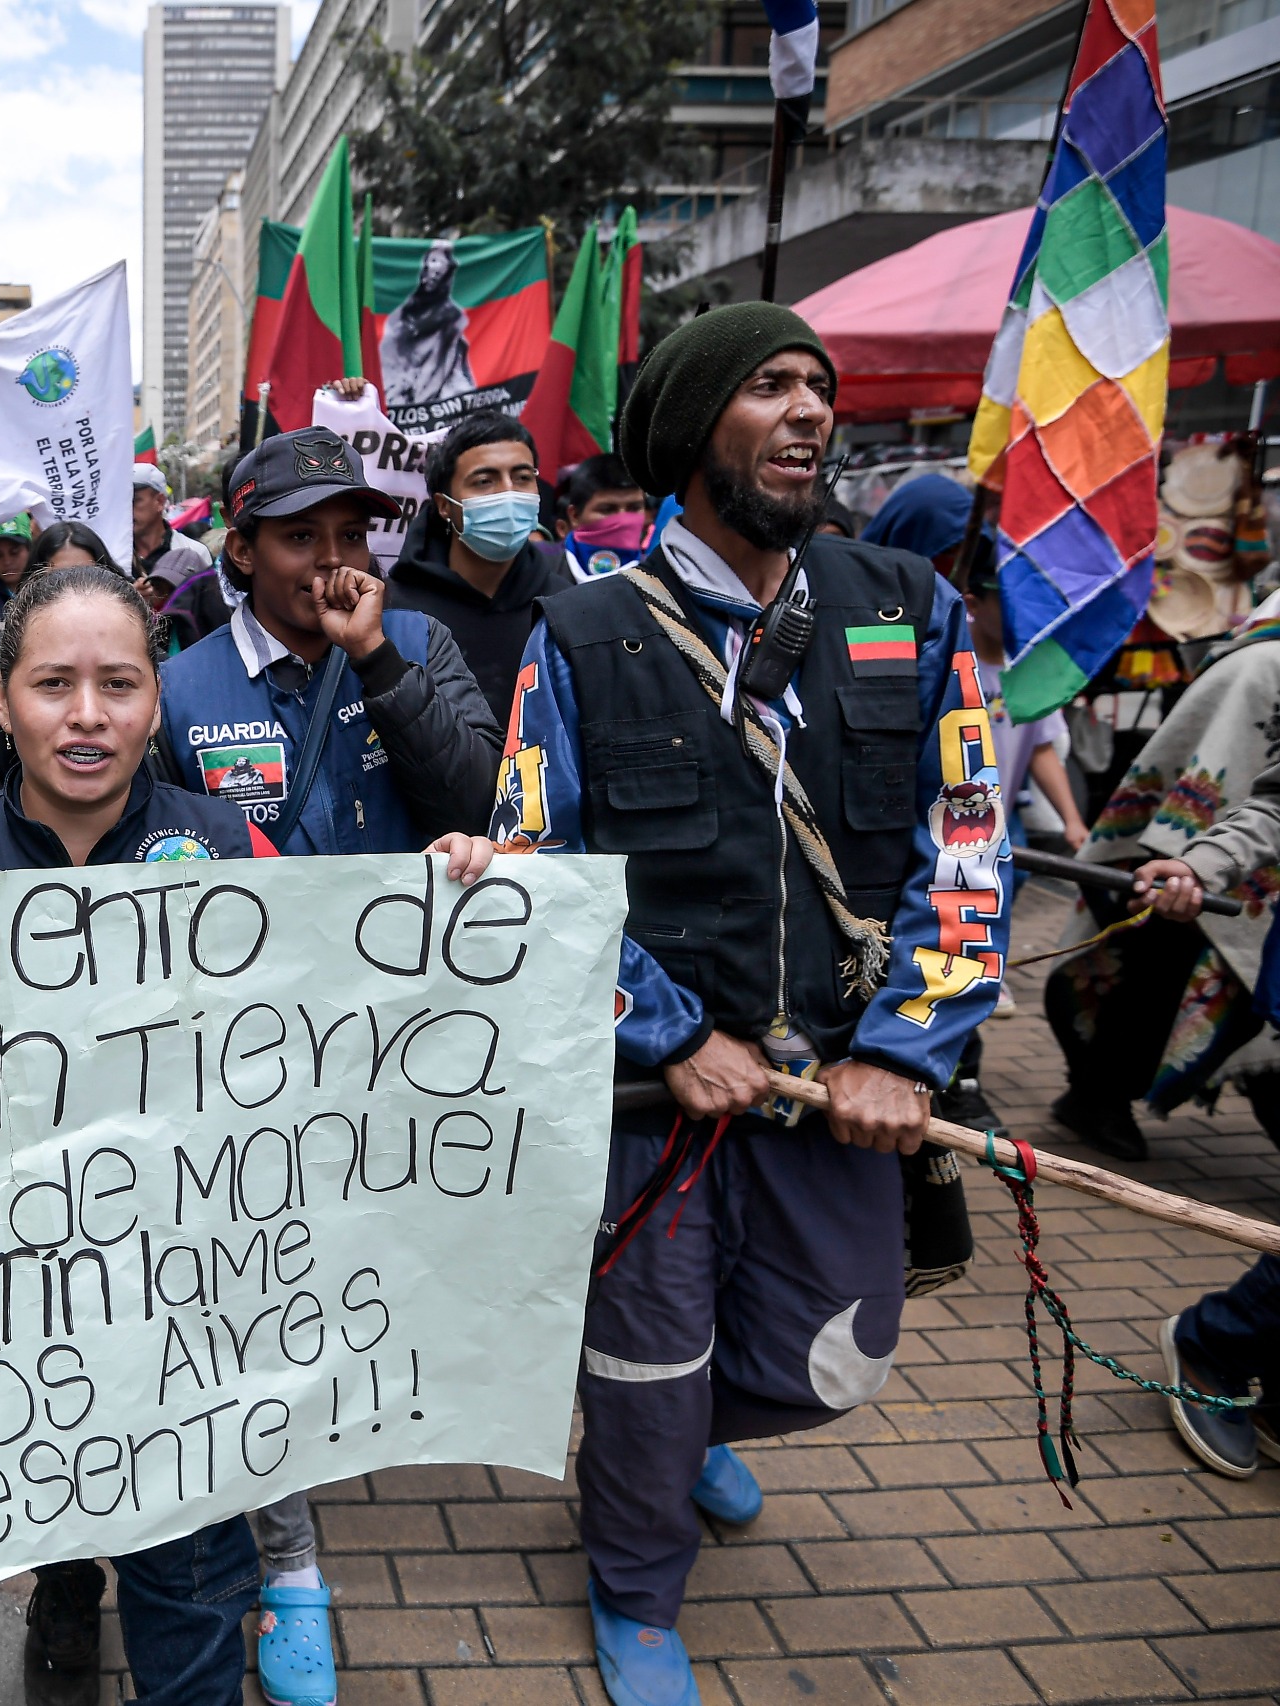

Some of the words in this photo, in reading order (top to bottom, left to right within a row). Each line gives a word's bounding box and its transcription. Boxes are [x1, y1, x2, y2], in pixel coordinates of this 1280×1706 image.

[396, 406, 429, 425] LOS
[430, 397, 463, 419] SIN
[76, 417, 95, 448] POR
[36, 437, 52, 456] EL
[58, 437, 76, 458] DE
[85, 448, 99, 468] LA
[65, 459, 81, 479] LA
[71, 480, 86, 509] VIDA
[188, 720, 288, 746] GUARDIA
[241, 803, 280, 824] TOS
[184, 828, 197, 838] DE
[354, 855, 533, 987] de
[95, 1003, 507, 1115] Tierra
[8, 1148, 140, 1252] de
